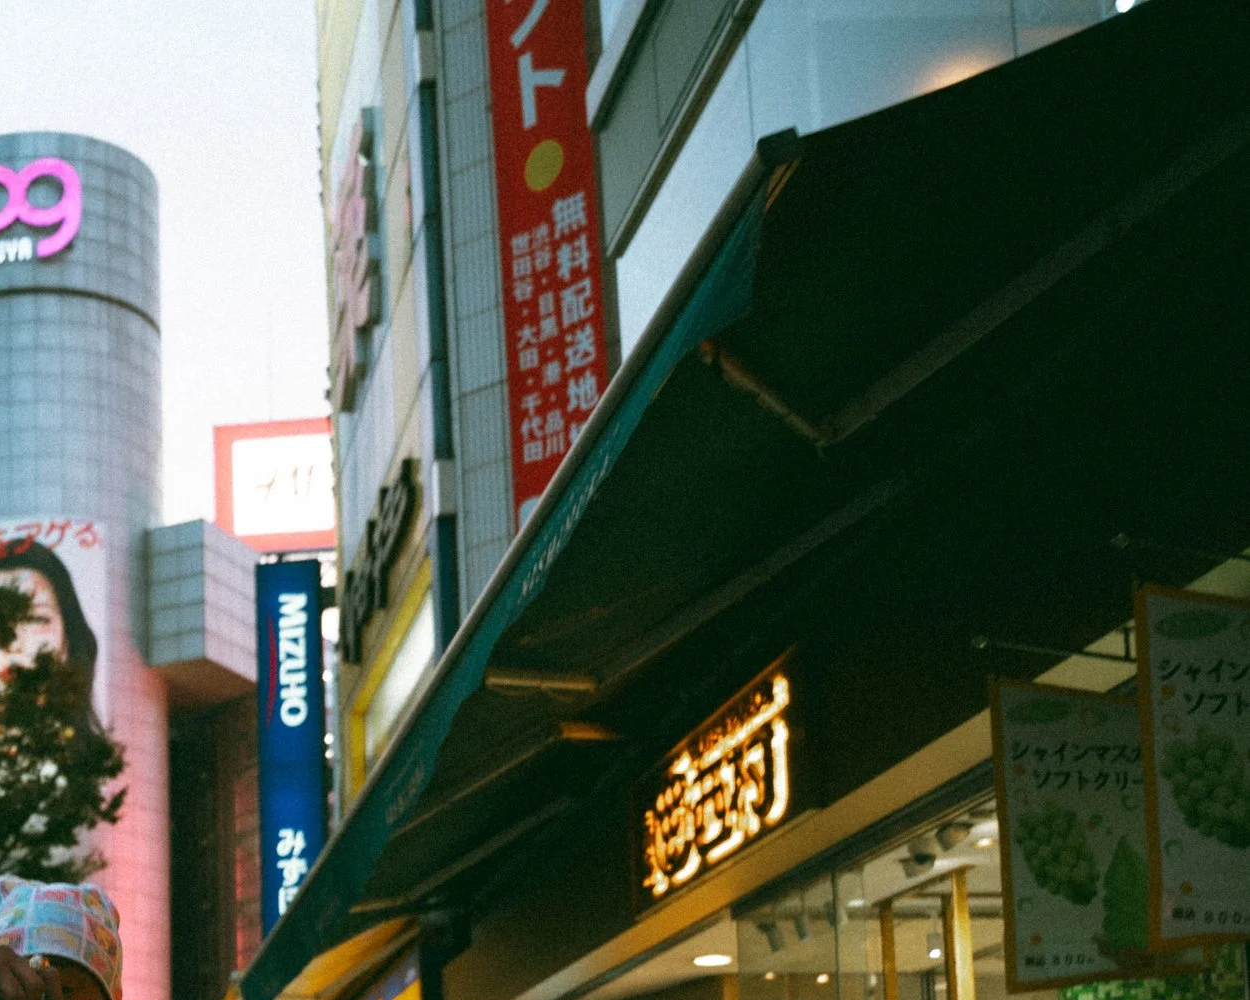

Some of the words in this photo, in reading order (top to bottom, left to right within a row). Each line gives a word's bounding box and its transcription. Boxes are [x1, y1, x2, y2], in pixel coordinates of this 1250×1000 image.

[553, 191, 600, 444] 無料配送地
[278, 592, 309, 728] MIZUHO
